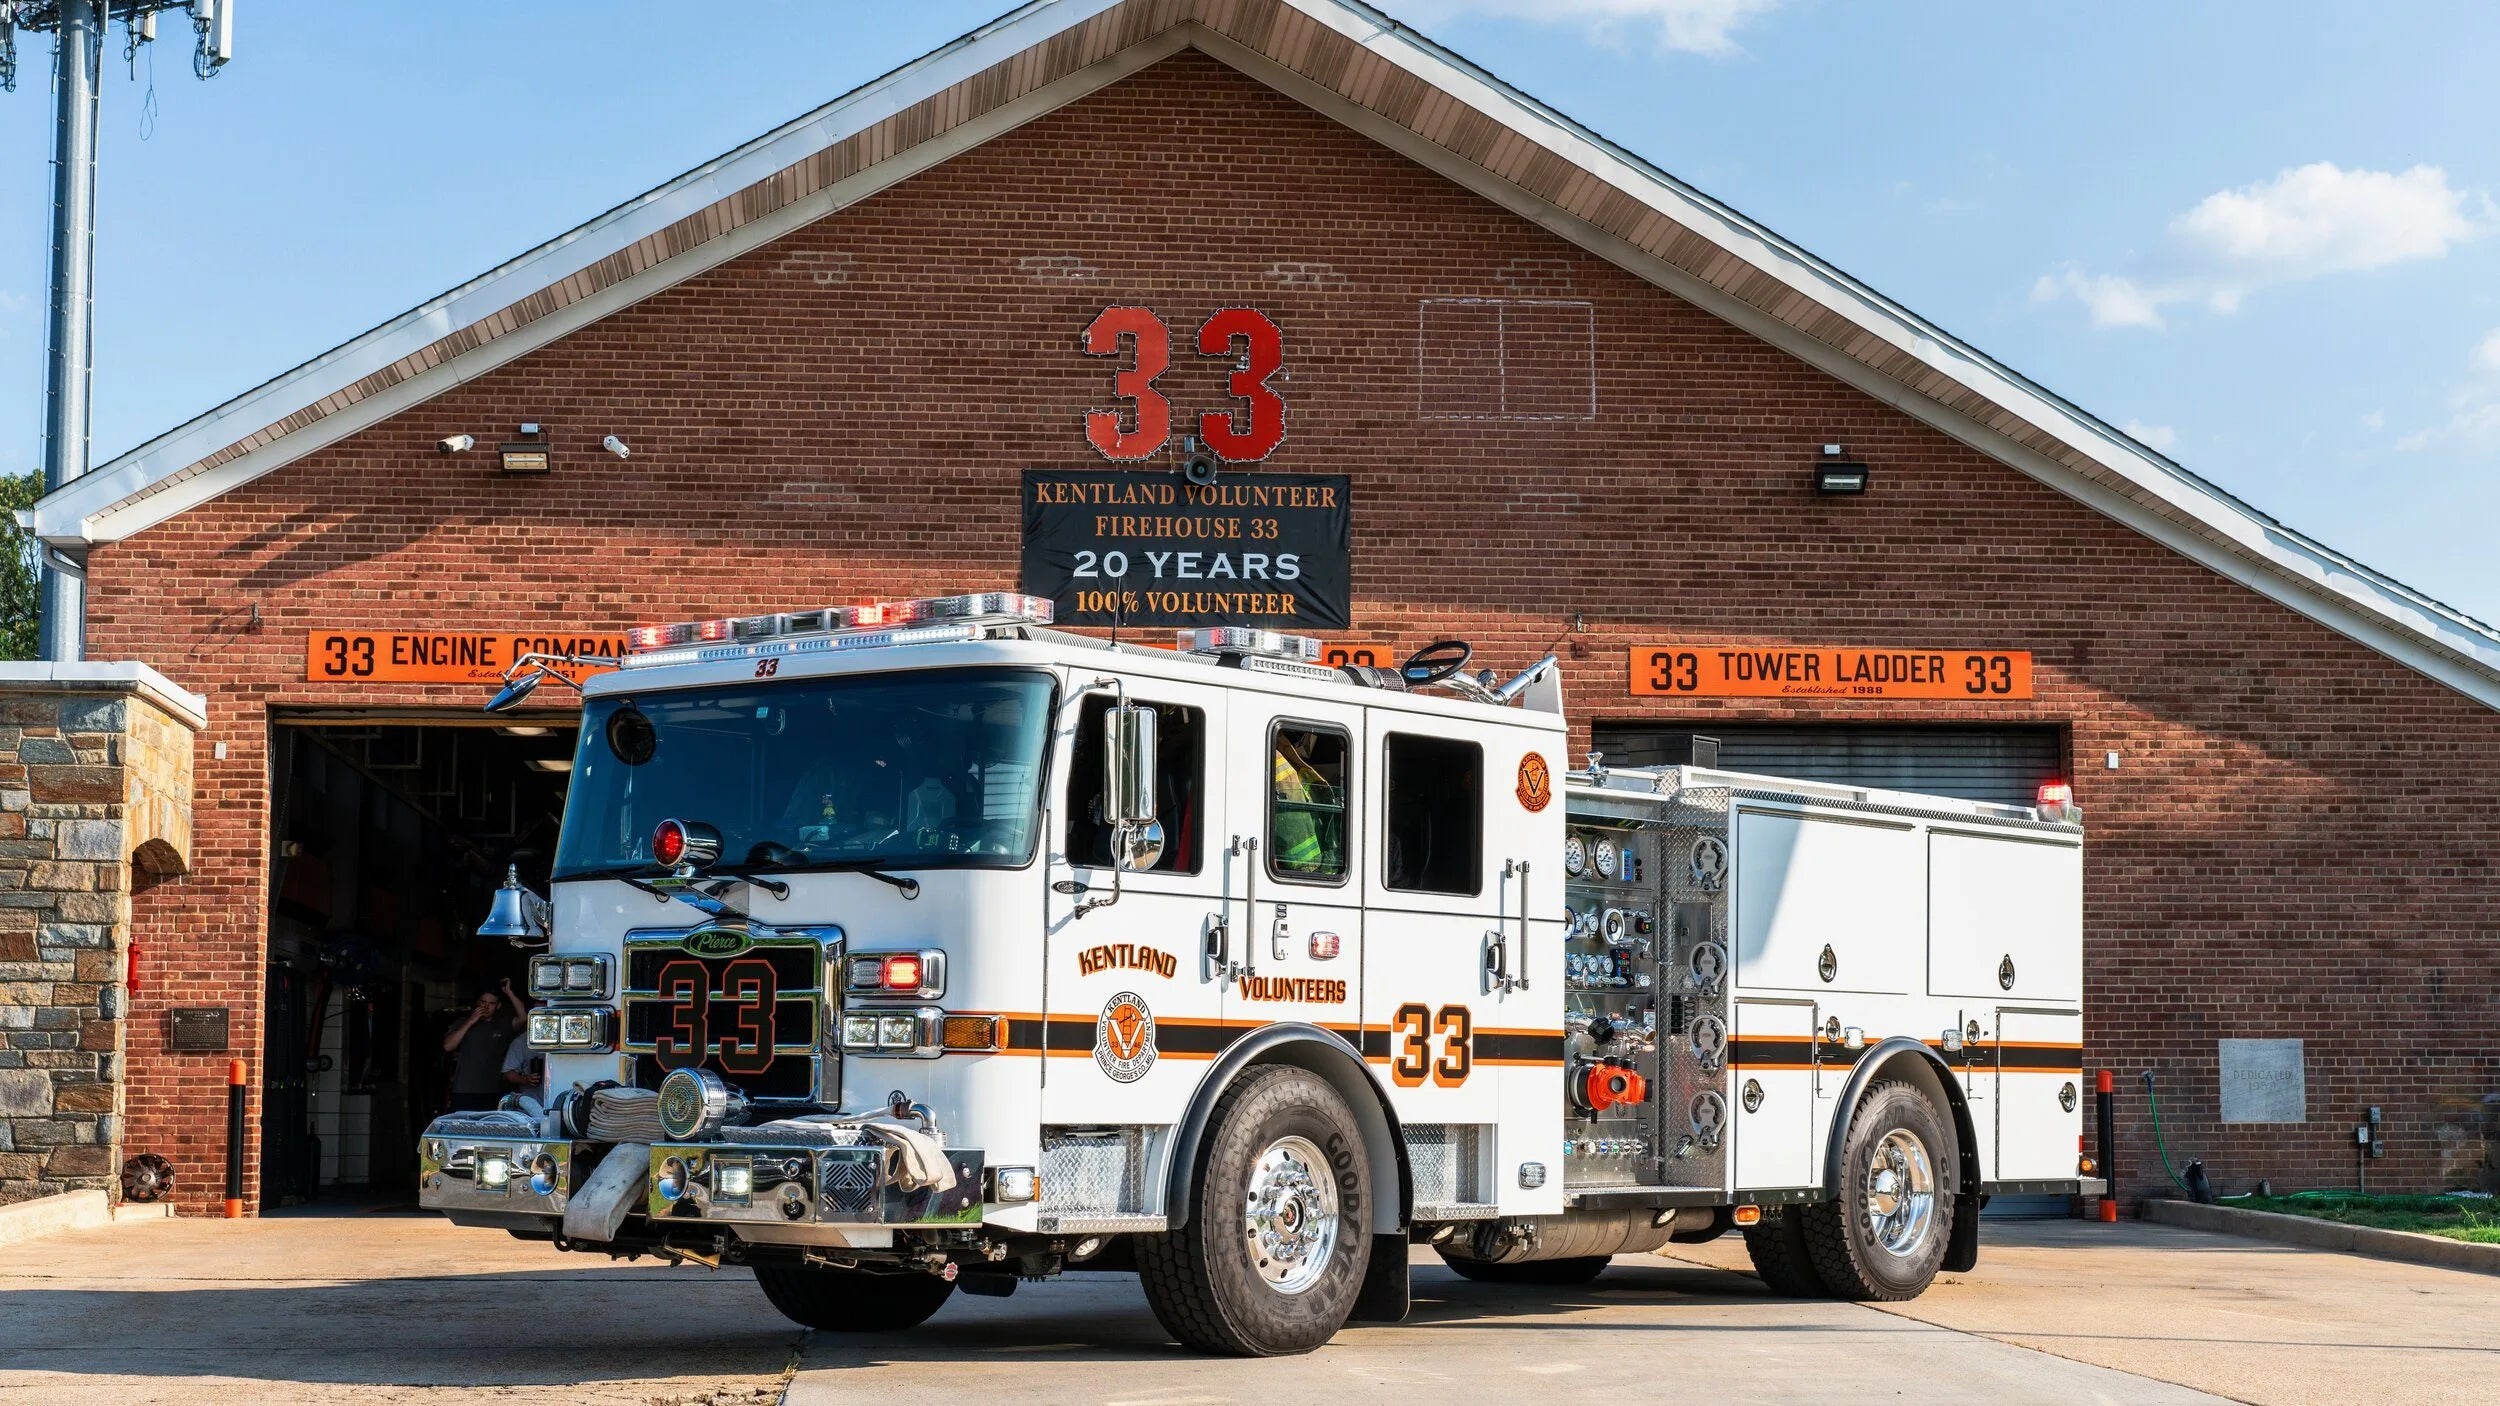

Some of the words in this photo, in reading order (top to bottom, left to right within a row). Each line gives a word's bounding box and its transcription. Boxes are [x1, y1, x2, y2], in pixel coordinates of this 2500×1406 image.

[1083, 304, 1287, 462] 33
[1036, 482, 1175, 505] KENTLAND
[1184, 484, 1337, 508] VOLUNTEER
[1095, 515, 1241, 539] FIREHOUSE
[1251, 518, 1279, 539] 33
[1073, 550, 1129, 578] 20
[1144, 551, 1301, 581] YEARS
[1076, 590, 1140, 613] 100%
[1146, 591, 1297, 615] VOLUNTEER
[325, 636, 375, 677] 33
[392, 636, 497, 667] ENGINE
[755, 658, 779, 678] 33
[1650, 652, 1698, 691] 33
[1718, 652, 1820, 682] TOWER
[1836, 654, 1946, 684] LADDER
[1965, 655, 2012, 694] 33
[1781, 685, 1848, 694] Established
[1853, 686, 1883, 694] 1988
[697, 933, 736, 951] Pierce
[1078, 944, 1177, 979] KENTLAND
[1107, 994, 1147, 1014] KENTLAND
[1239, 976, 1347, 1004] VOLUNTEERS
[656, 959, 777, 1074] 33
[1102, 1020, 1117, 1063] VOLUNTEER
[1118, 1061, 1130, 1069] FIRE
[1132, 1021, 1151, 1066] DEPARTMENT
[1391, 1003, 1471, 1088] 33
[1098, 1051, 1112, 1073] PRINCE
[2233, 1070, 2293, 1081] DEDICATED
[1309, 1131, 1360, 1316] GOODYEAR
